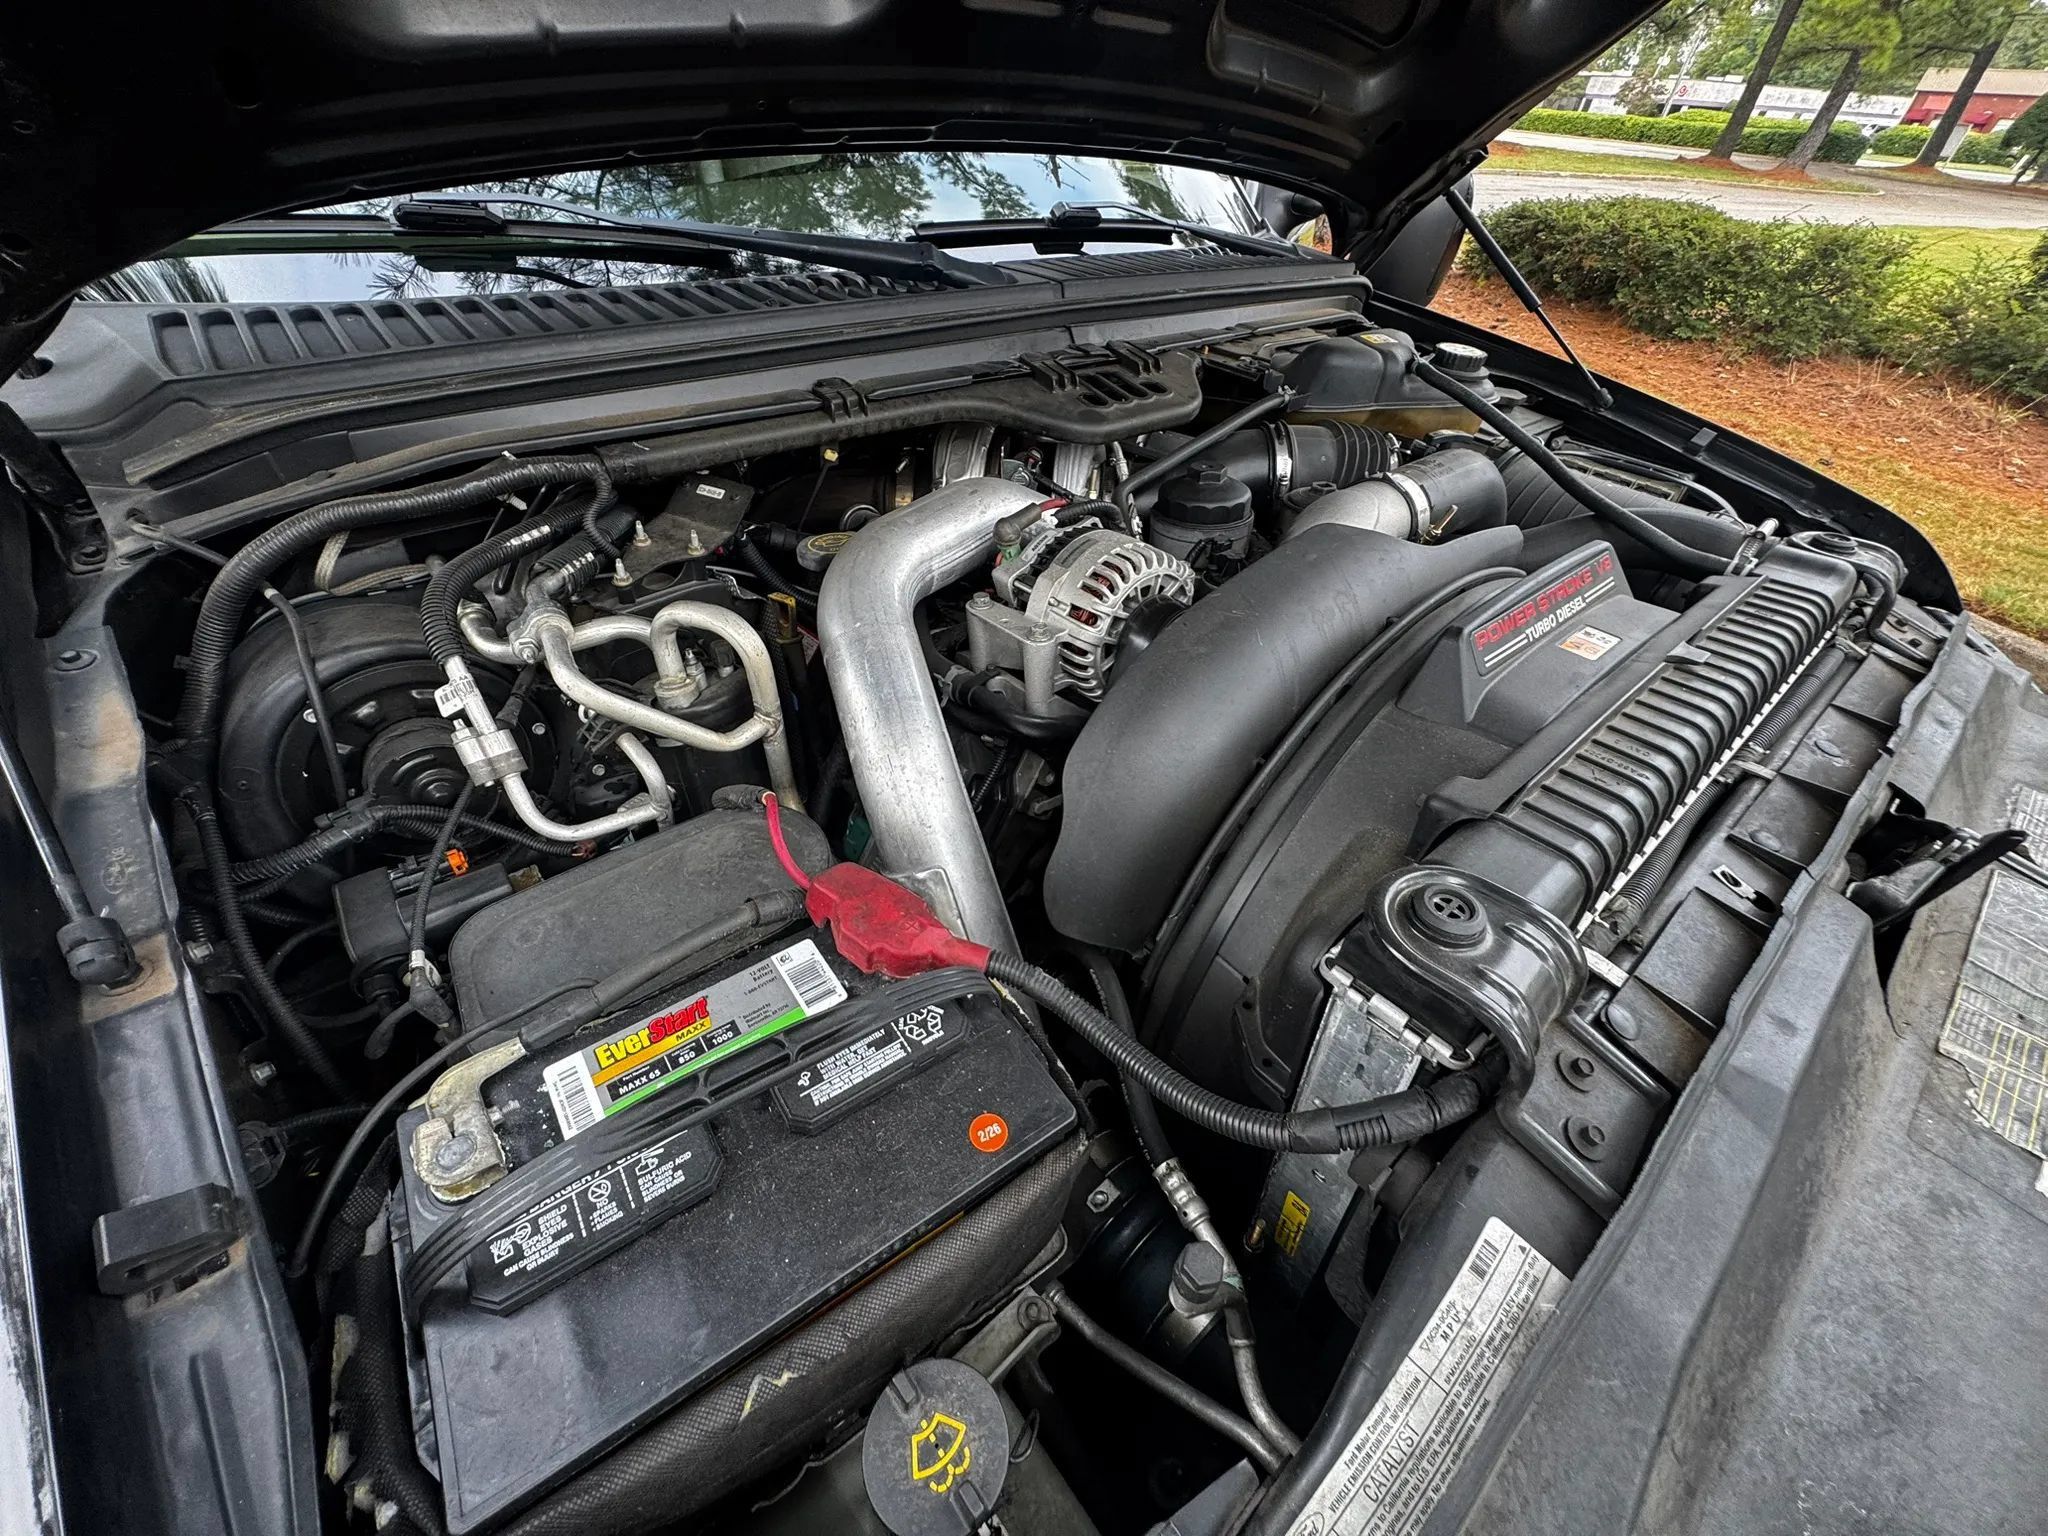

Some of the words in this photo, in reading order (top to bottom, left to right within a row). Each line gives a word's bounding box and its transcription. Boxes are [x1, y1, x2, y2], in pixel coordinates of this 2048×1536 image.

[1474, 600, 1536, 651] POWER
[1537, 566, 1592, 613] STROKE
[1595, 553, 1613, 576] V8
[1526, 613, 1557, 642] TURBO
[1556, 594, 1584, 622] DIESEL
[748, 963, 770, 977] 12-VOLT
[752, 968, 774, 982] Battery
[595, 997, 709, 1069] EverStart
[675, 1020, 706, 1041] MAXX
[711, 1030, 734, 1045] 1000
[678, 1050, 695, 1064] 850
[815, 1054, 836, 1070] FLUSH
[834, 1047, 850, 1060] EYES
[848, 1027, 886, 1052] IMMEDIATELY
[819, 1062, 836, 1075] WITH
[822, 1062, 848, 1080] MEDICAL
[846, 1054, 862, 1066] HELP
[861, 1046, 877, 1058] FAST
[619, 1074, 647, 1095] MAXX
[648, 1068, 660, 1080] 65
[977, 1122, 1002, 1143] 2/26
[637, 1160, 674, 1186] SULFURIC
[674, 1150, 691, 1165] ACID
[639, 1179, 652, 1191] CAN
[654, 1168, 672, 1183] CAUSE
[642, 1175, 672, 1197] BLINDNESS
[674, 1168, 682, 1179] OR
[643, 1186, 666, 1203] SEVERE
[666, 1174, 684, 1189] BURNS
[538, 1203, 567, 1225] SHIELD
[592, 1200, 616, 1218] SPARKS
[594, 1206, 617, 1224] FLAMES
[596, 1197, 608, 1210] NO
[539, 1214, 561, 1232] EYES
[595, 1210, 622, 1230] SMOKING
[521, 1218, 567, 1250] EXPLOSIVE
[523, 1235, 552, 1257] GASES
[504, 1263, 518, 1277] CAN
[519, 1251, 539, 1268] CAUSE
[540, 1231, 574, 1255] BLINDNESS
[526, 1260, 536, 1271] OR
[537, 1247, 559, 1265] INJURY
[1377, 1512, 1386, 1523] to
[1382, 1475, 1409, 1515] California
[1406, 1434, 1436, 1479] regulations
[1431, 1398, 1457, 1437] applicable
[1453, 1388, 1463, 1400] to
[1458, 1369, 1473, 1391] 2005
[1469, 1347, 1486, 1372] model
[1483, 1331, 1498, 1351] year
[1493, 1316, 1505, 1334] new
[1500, 1295, 1516, 1318] ULEV
[1343, 1450, 1358, 1469] Ford
[1354, 1431, 1370, 1454] Motor
[1367, 1401, 1391, 1436] Company
[1384, 1507, 1405, 1536] ngines,
[1401, 1491, 1414, 1510] and
[1411, 1482, 1420, 1494] to
[1426, 1448, 1441, 1467] EPA
[1436, 1407, 1466, 1452] regulations
[1460, 1370, 1486, 1410] applicable
[1505, 1310, 1520, 1330] OBD
[1328, 1482, 1351, 1514] VEHICLE
[1346, 1450, 1373, 1487] EMISSION
[1368, 1421, 1392, 1454] CONTROL
[1388, 1375, 1422, 1423] INFORMATION
[1361, 1418, 1421, 1503] CATALYST
[1409, 1512, 1424, 1533] may
[1430, 1481, 1441, 1496] No
[1437, 1462, 1452, 1484] other
[1448, 1423, 1477, 1467] adjustments
